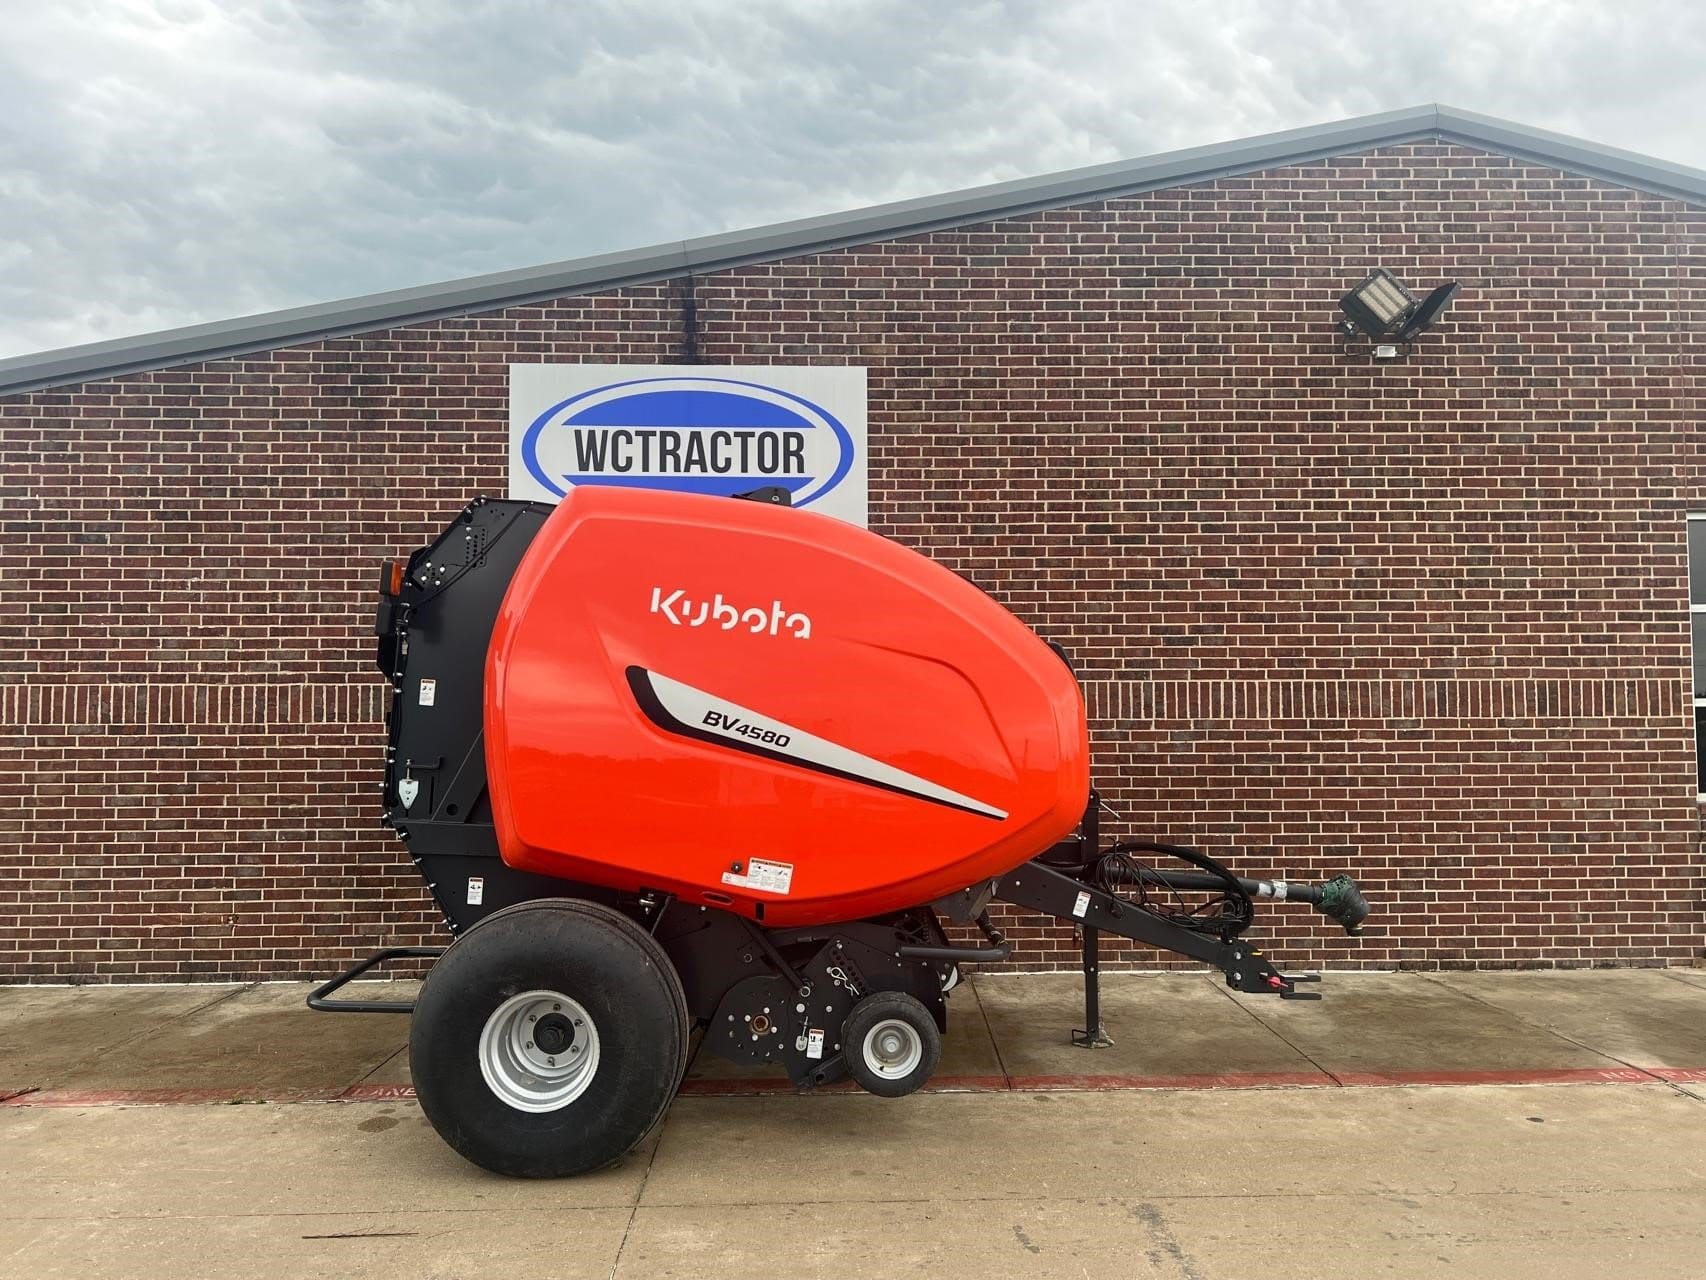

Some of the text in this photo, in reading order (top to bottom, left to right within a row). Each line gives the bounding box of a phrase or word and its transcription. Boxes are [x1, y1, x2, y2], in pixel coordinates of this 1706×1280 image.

[574, 429, 805, 474] WCTRACTOR
[650, 587, 811, 639] Kubota
[702, 710, 791, 748] BV4580
[352, 1087, 417, 1096] LANE
